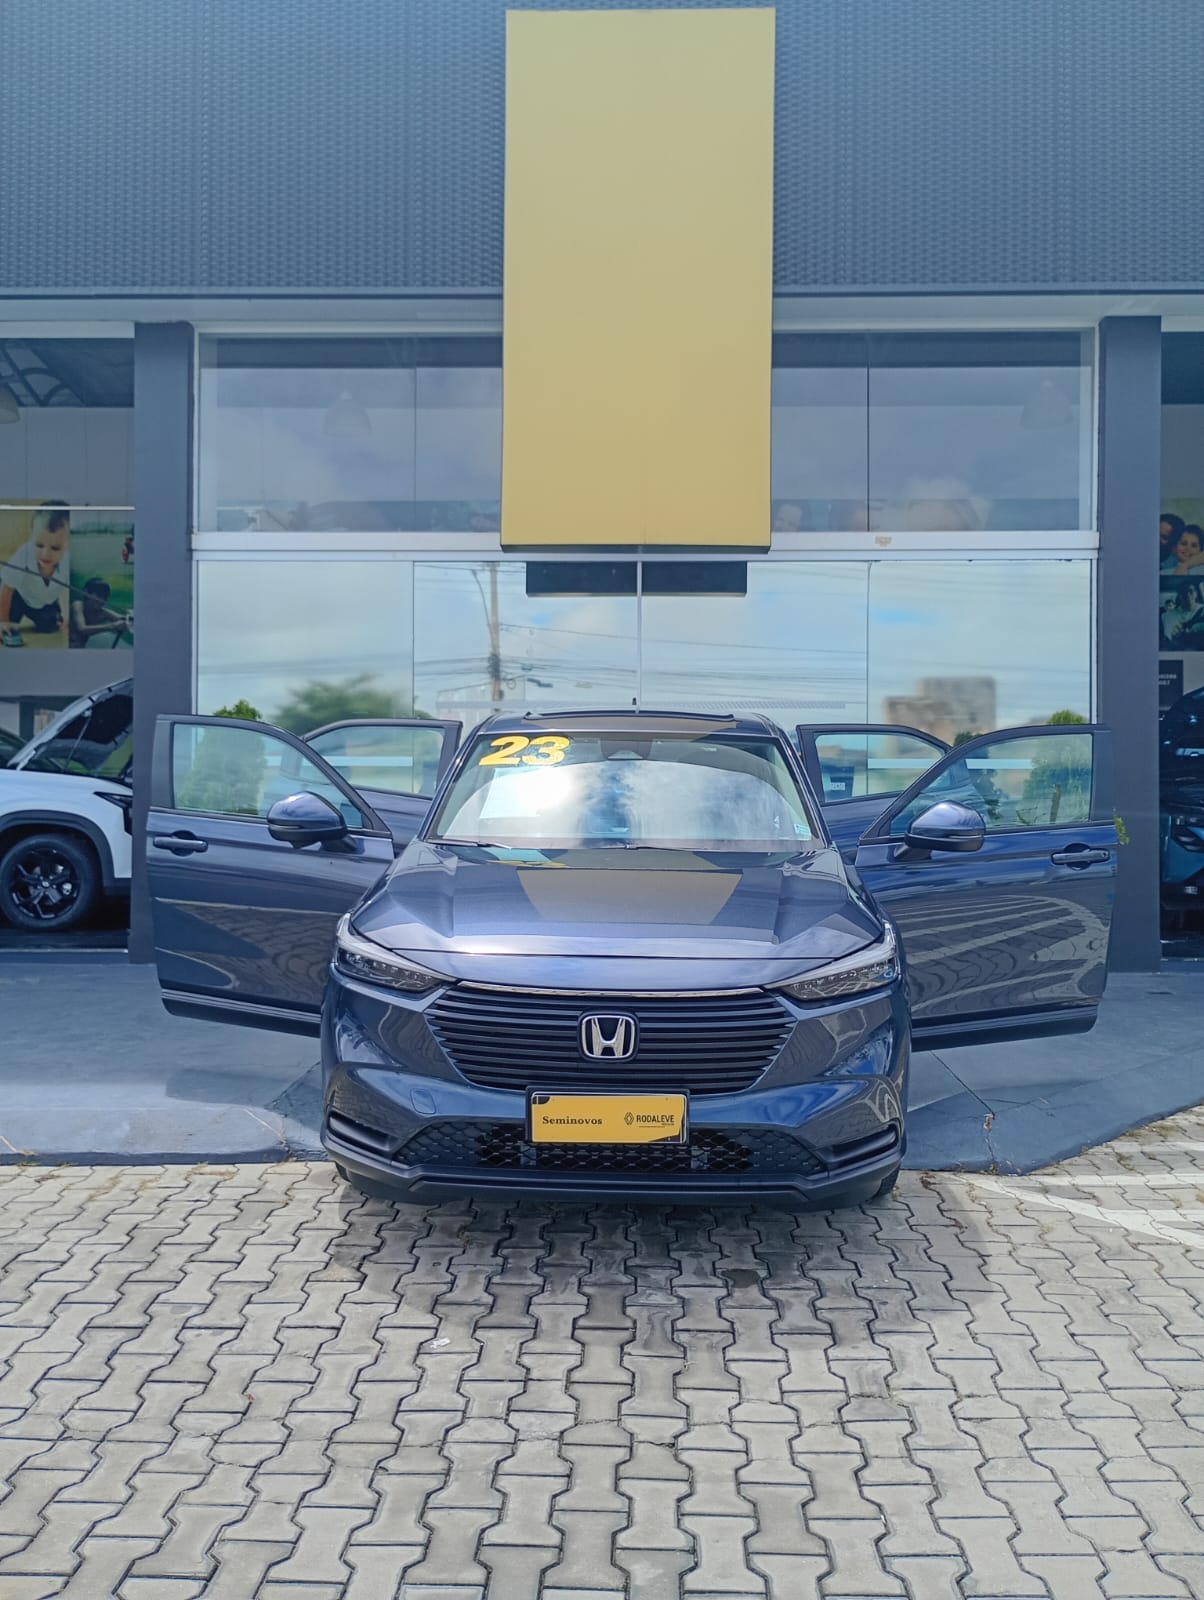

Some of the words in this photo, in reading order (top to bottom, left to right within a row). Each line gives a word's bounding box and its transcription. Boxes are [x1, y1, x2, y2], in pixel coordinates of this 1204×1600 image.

[479, 735, 570, 767] 23
[542, 1115, 603, 1125] Seminovos
[636, 1114, 675, 1123] RODALEVE
